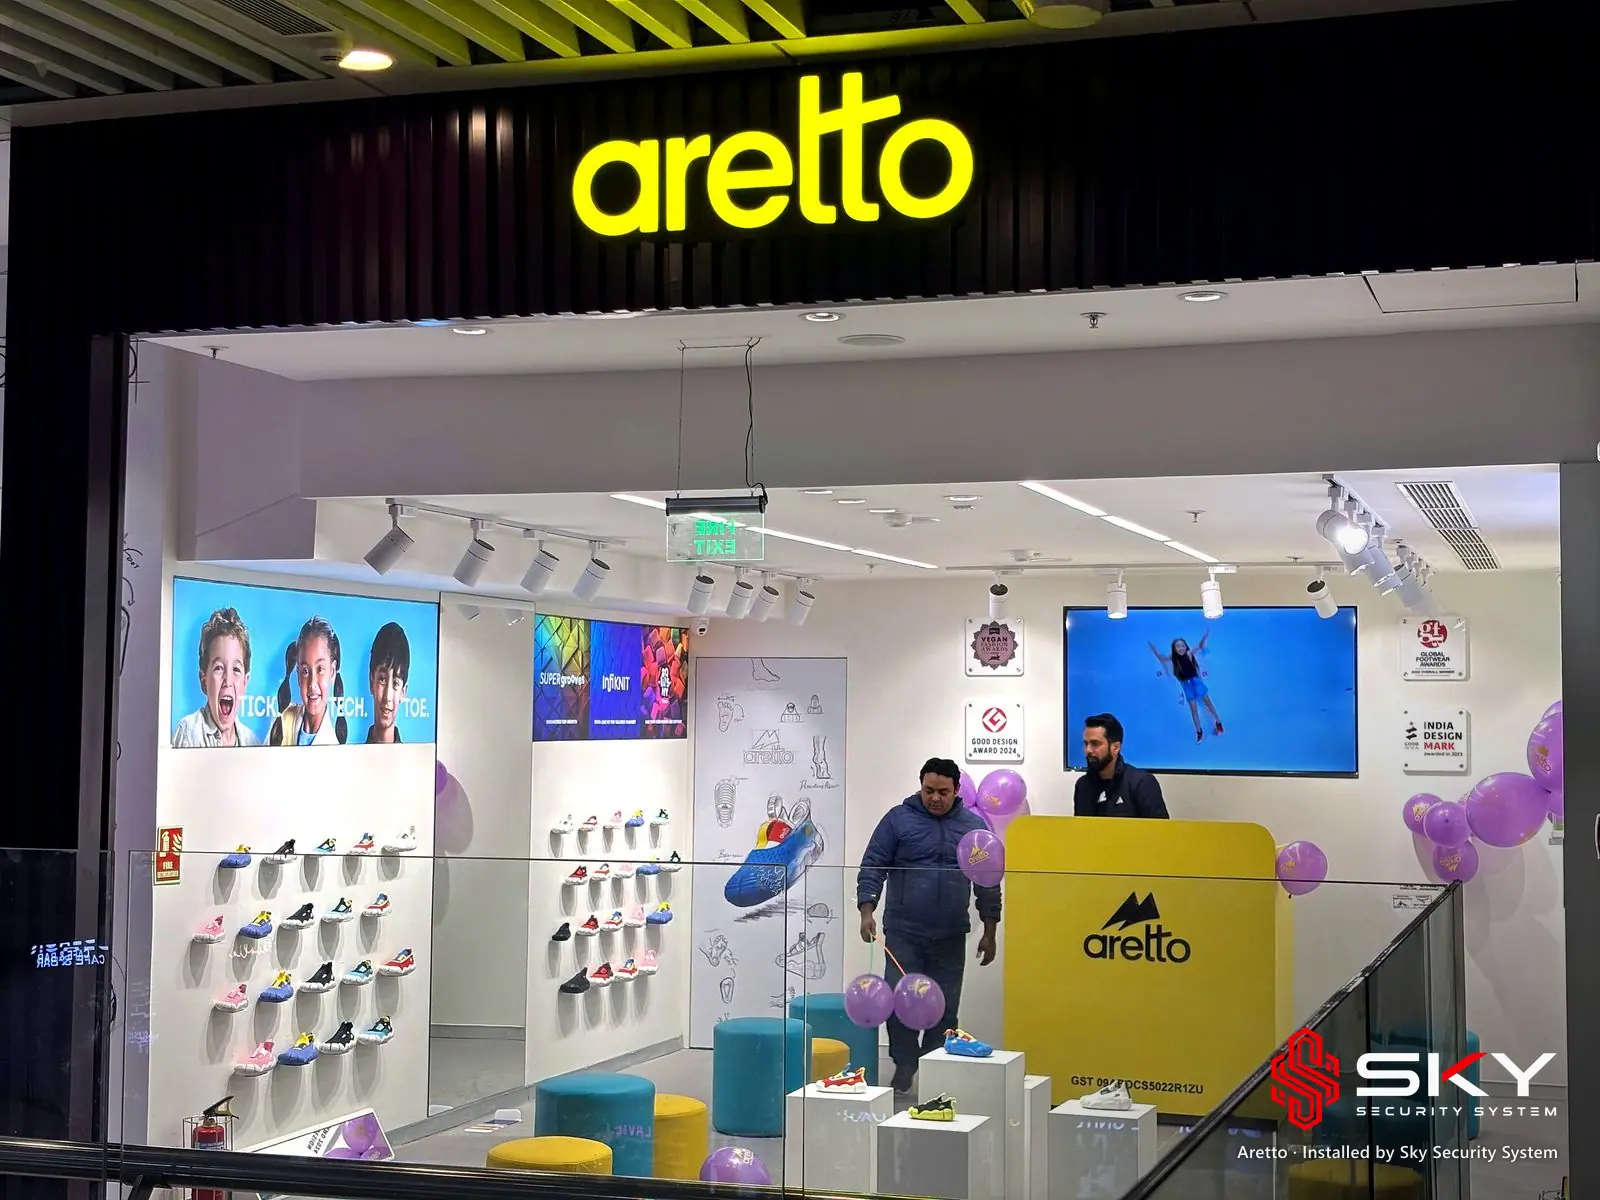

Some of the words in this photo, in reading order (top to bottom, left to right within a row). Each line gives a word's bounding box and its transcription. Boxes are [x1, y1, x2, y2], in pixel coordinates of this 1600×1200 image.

[572, 72, 975, 237] aretto
[402, 698, 430, 718] TOE.
[1423, 721, 1454, 730] INDIA
[1423, 731, 1463, 740] DESIGN
[1423, 741, 1456, 750] MARK
[743, 745, 795, 765] aretto
[1083, 924, 1191, 963] aretto
[1071, 1075, 1094, 1087] GST
